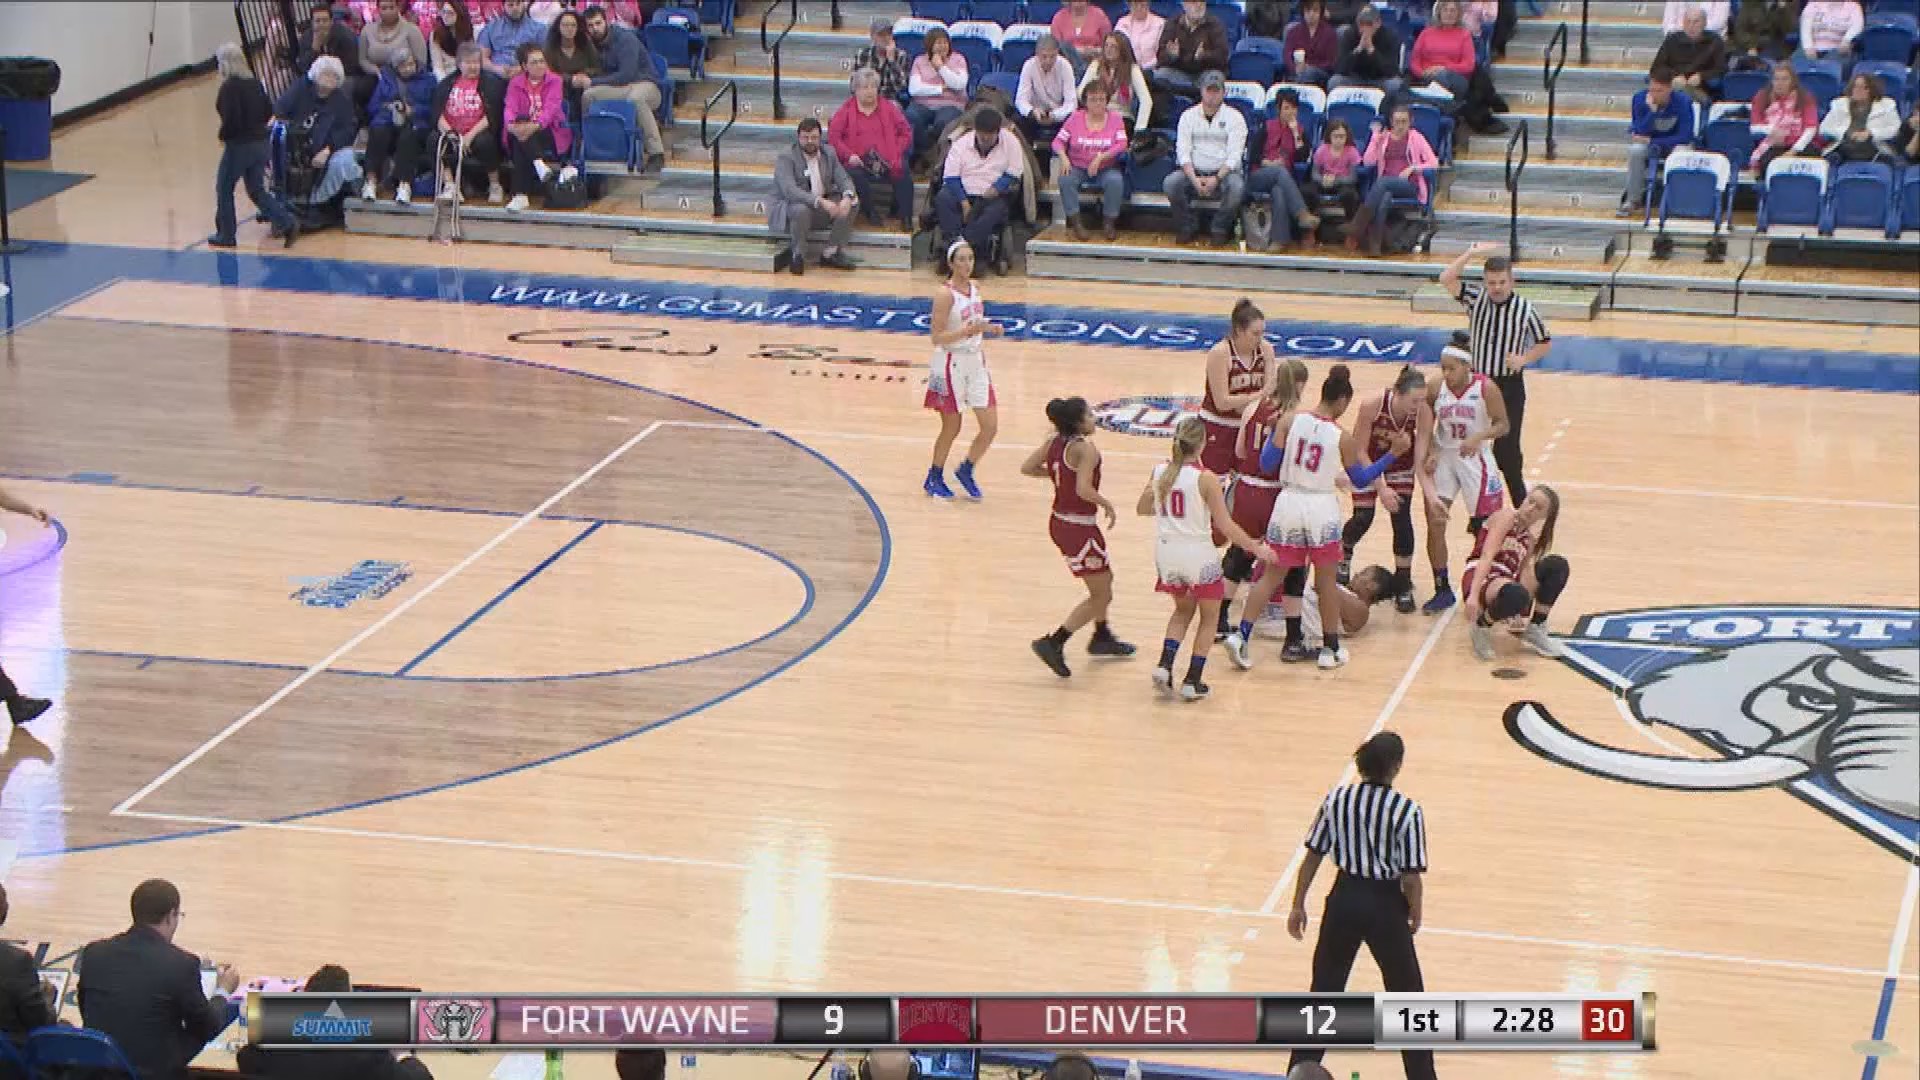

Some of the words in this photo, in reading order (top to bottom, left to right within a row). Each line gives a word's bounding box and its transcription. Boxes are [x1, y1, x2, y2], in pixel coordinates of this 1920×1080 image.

[491, 283, 1416, 358] WWW.GOMASTDONS.OM
[1295, 437, 1323, 472] 13
[1627, 616, 1913, 641] FORT
